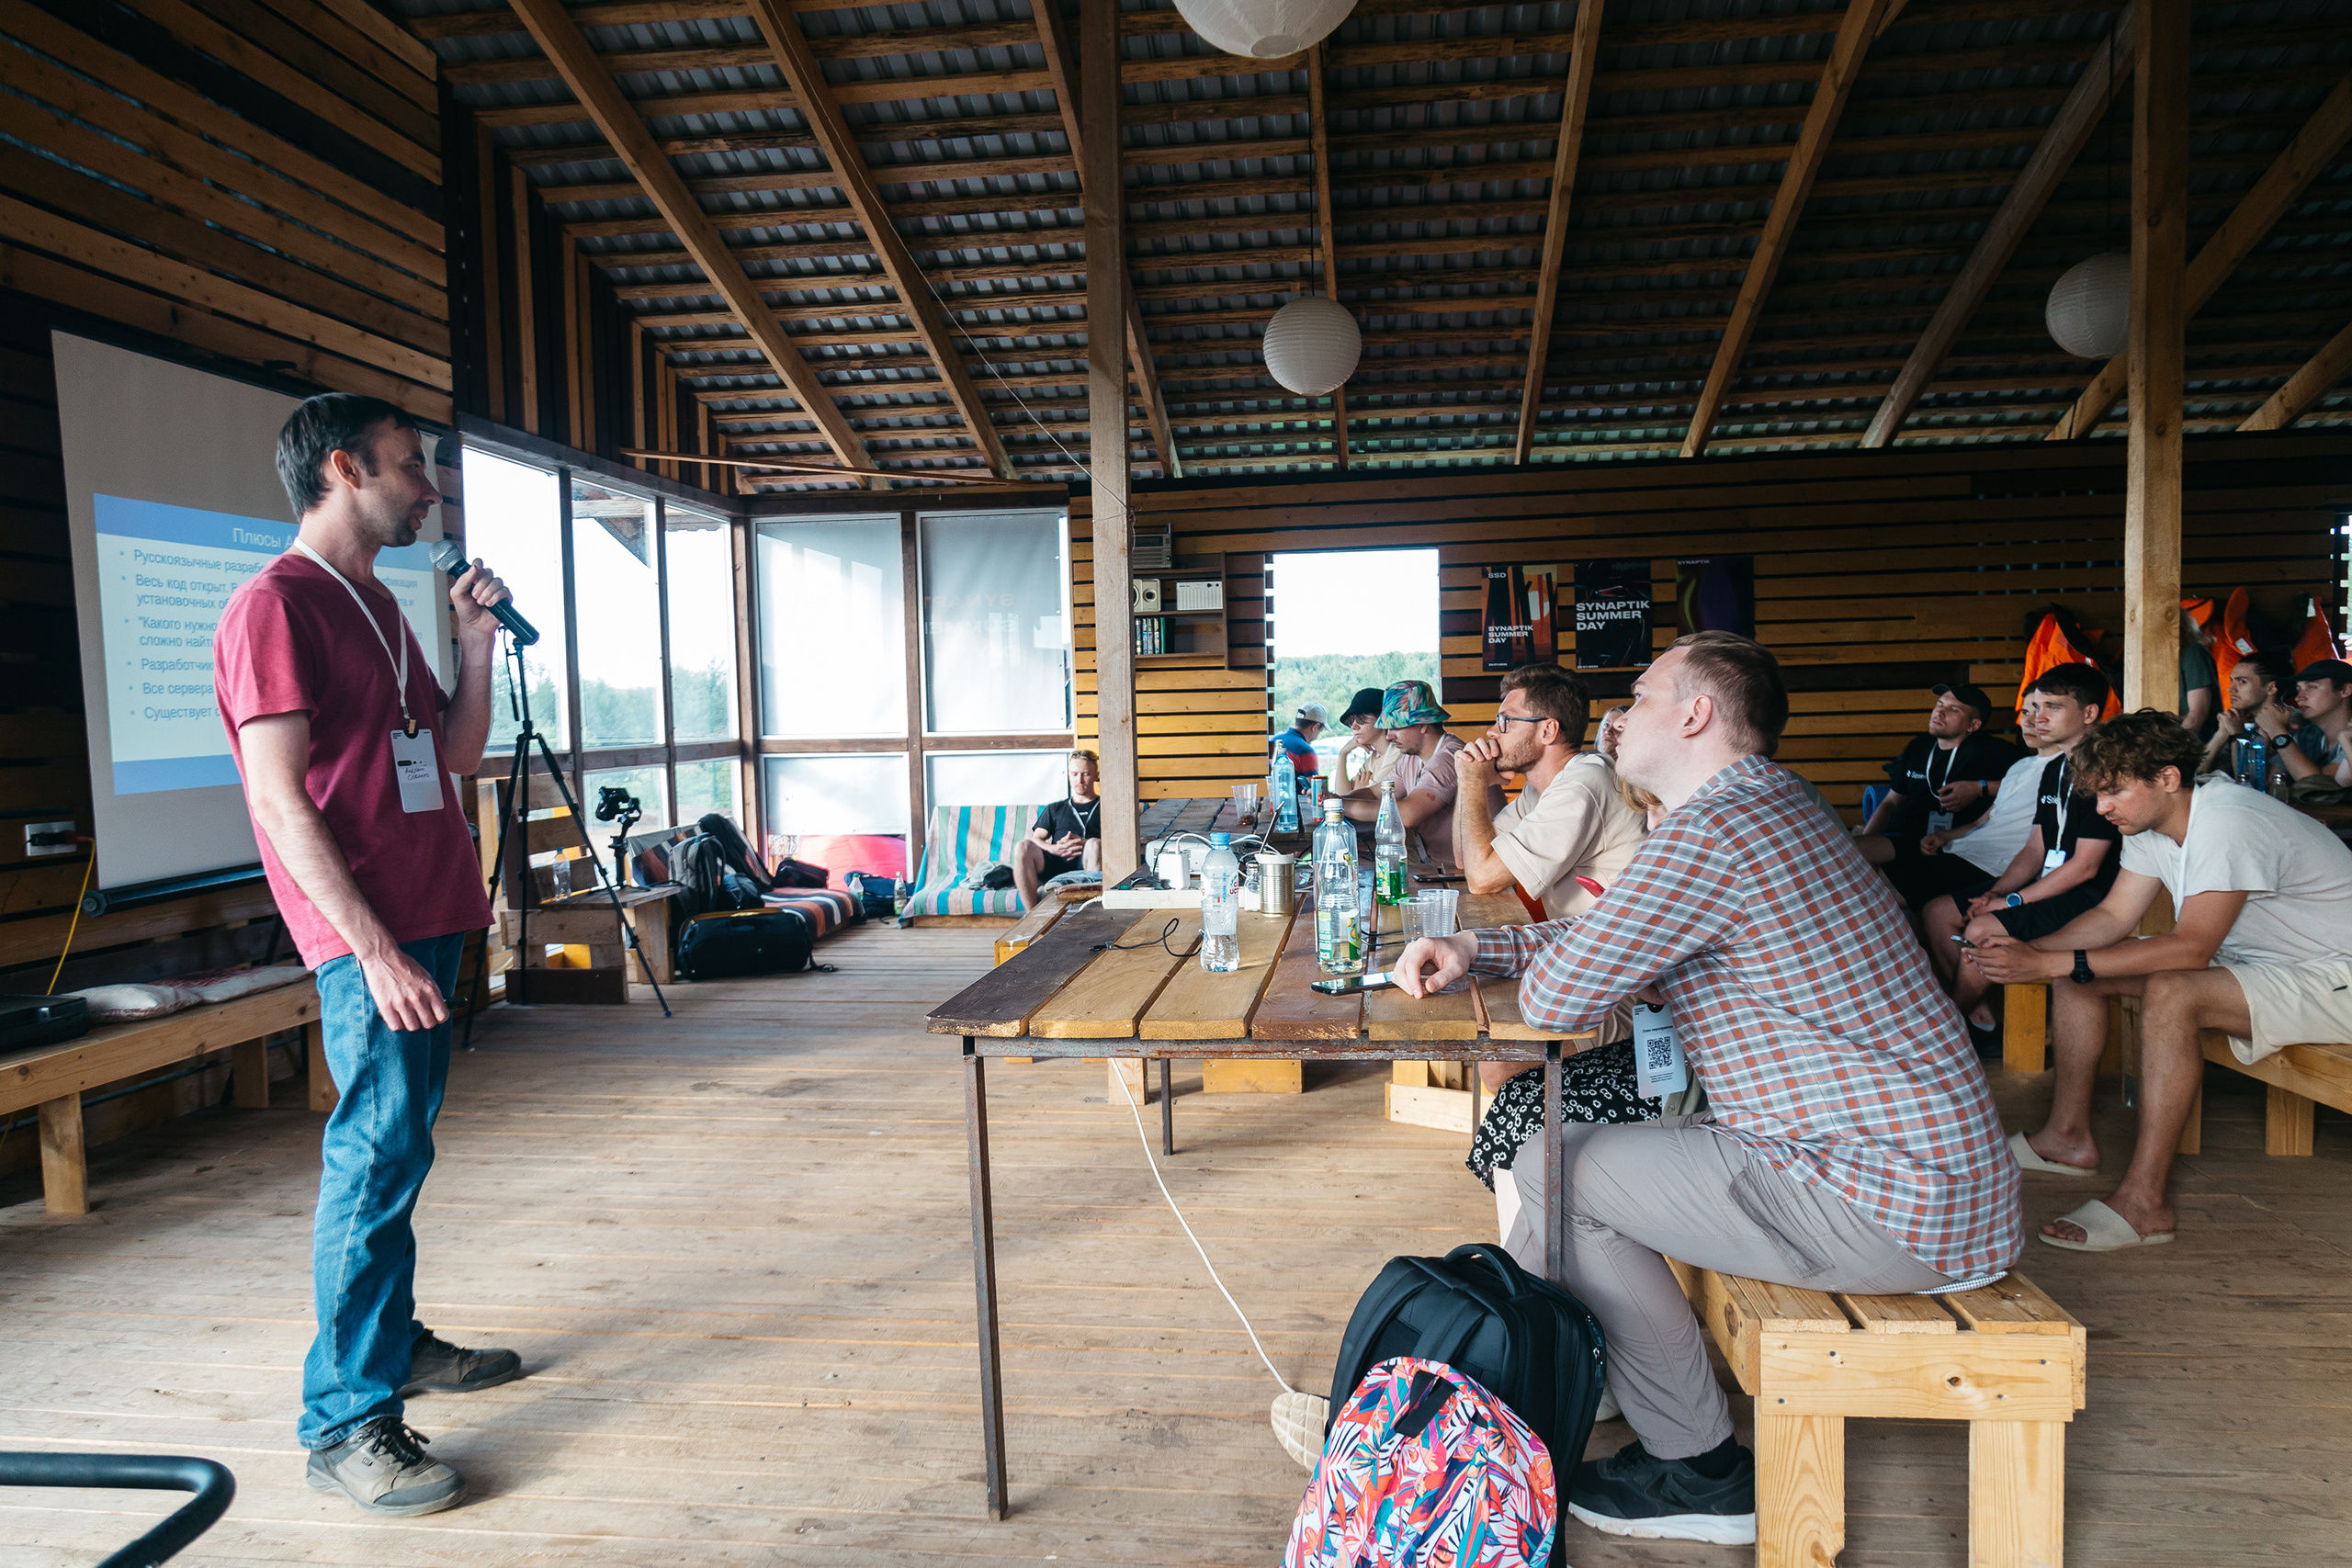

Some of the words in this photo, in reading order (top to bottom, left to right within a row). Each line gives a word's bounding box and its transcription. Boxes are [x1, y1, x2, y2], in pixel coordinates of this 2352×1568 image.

[232, 527, 281, 548] Плюсы
[134, 549, 221, 570] Русскоязычные
[136, 574, 164, 588] Весь
[167, 579, 187, 592] код
[136, 593, 216, 609] установочных
[1576, 600, 1651, 612] SYNAPTIK
[1576, 610, 1643, 621] SUMMER
[1577, 621, 1606, 631] DAY
[140, 636, 183, 647] сложно
[142, 682, 164, 694] Все
[144, 706, 212, 722] Существует
